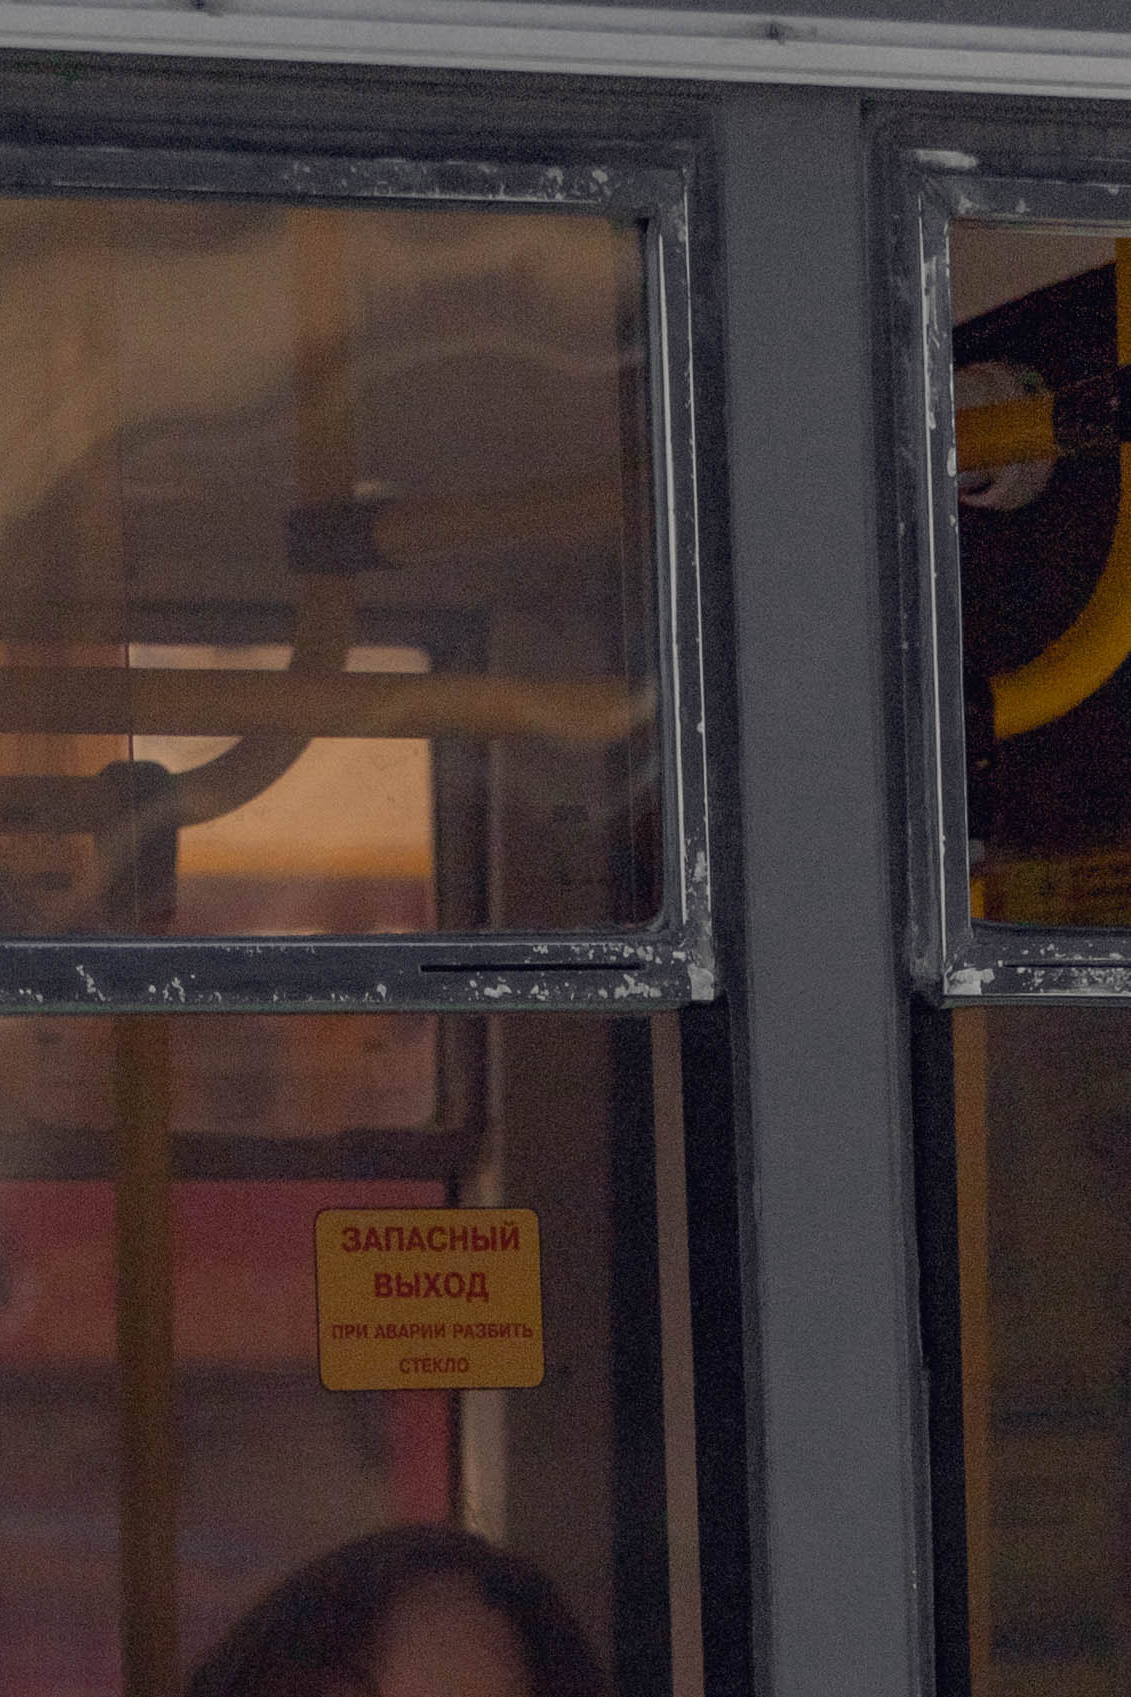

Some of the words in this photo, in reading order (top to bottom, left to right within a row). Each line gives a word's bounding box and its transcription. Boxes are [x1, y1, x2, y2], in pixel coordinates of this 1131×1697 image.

[341, 1220, 520, 1252] ЗАПАСНЫЙ
[373, 1271, 490, 1303] ВЫХОД
[332, 1324, 368, 1340] ПРИ
[374, 1323, 446, 1340] АВАРИИ
[452, 1322, 534, 1339] РАЗБИТЬ
[399, 1357, 471, 1374] СТЕКЛО
